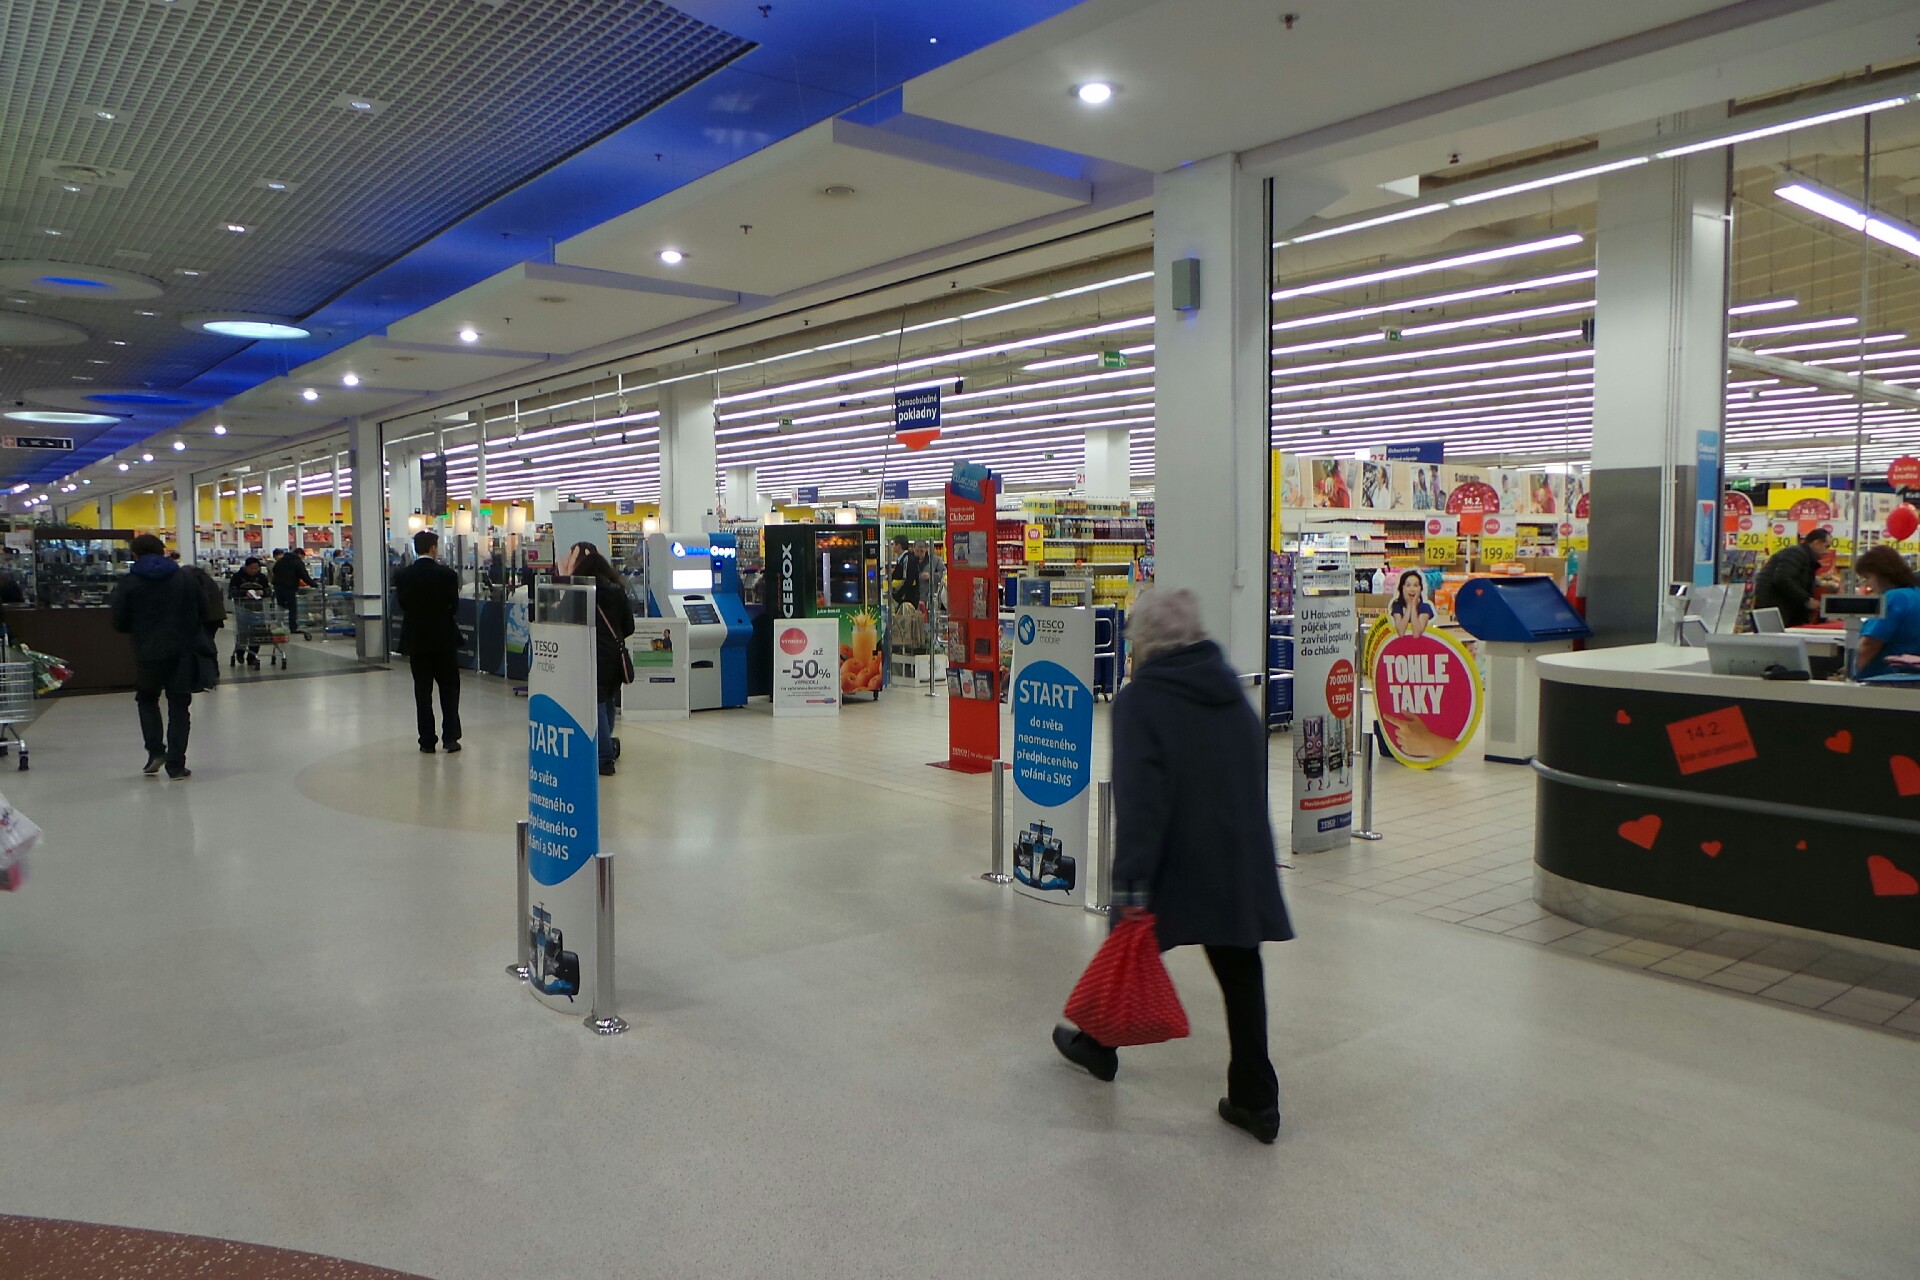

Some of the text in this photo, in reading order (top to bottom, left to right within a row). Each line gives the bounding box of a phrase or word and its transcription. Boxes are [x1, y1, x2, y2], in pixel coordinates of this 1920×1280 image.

[898, 405, 937, 424] pokladny
[950, 512, 975, 522] Clubcard
[1301, 610, 1309, 620] U
[1311, 608, 1351, 620] Hotovostních
[1037, 620, 1064, 630] TESCO
[1301, 621, 1342, 634] půjček jsme
[1039, 634, 1060, 645] mobile
[1301, 631, 1352, 645] zavřeli poplatky
[534, 640, 559, 653] TESCO
[812, 647, 824, 656] až
[1301, 644, 1340, 656] do chládku
[536, 660, 555, 673] mobile
[1383, 653, 1450, 684] TOHLE
[1019, 679, 1079, 709] START
[1389, 685, 1444, 715] TAKY
[1030, 715, 1064, 732] do světa
[1018, 733, 1077, 752] neomezeného
[1016, 749, 1079, 770] předplaceného
[529, 765, 558, 788] do světa
[1020, 767, 1072, 787] volání a SMS
[547, 841, 569, 861] SMS
